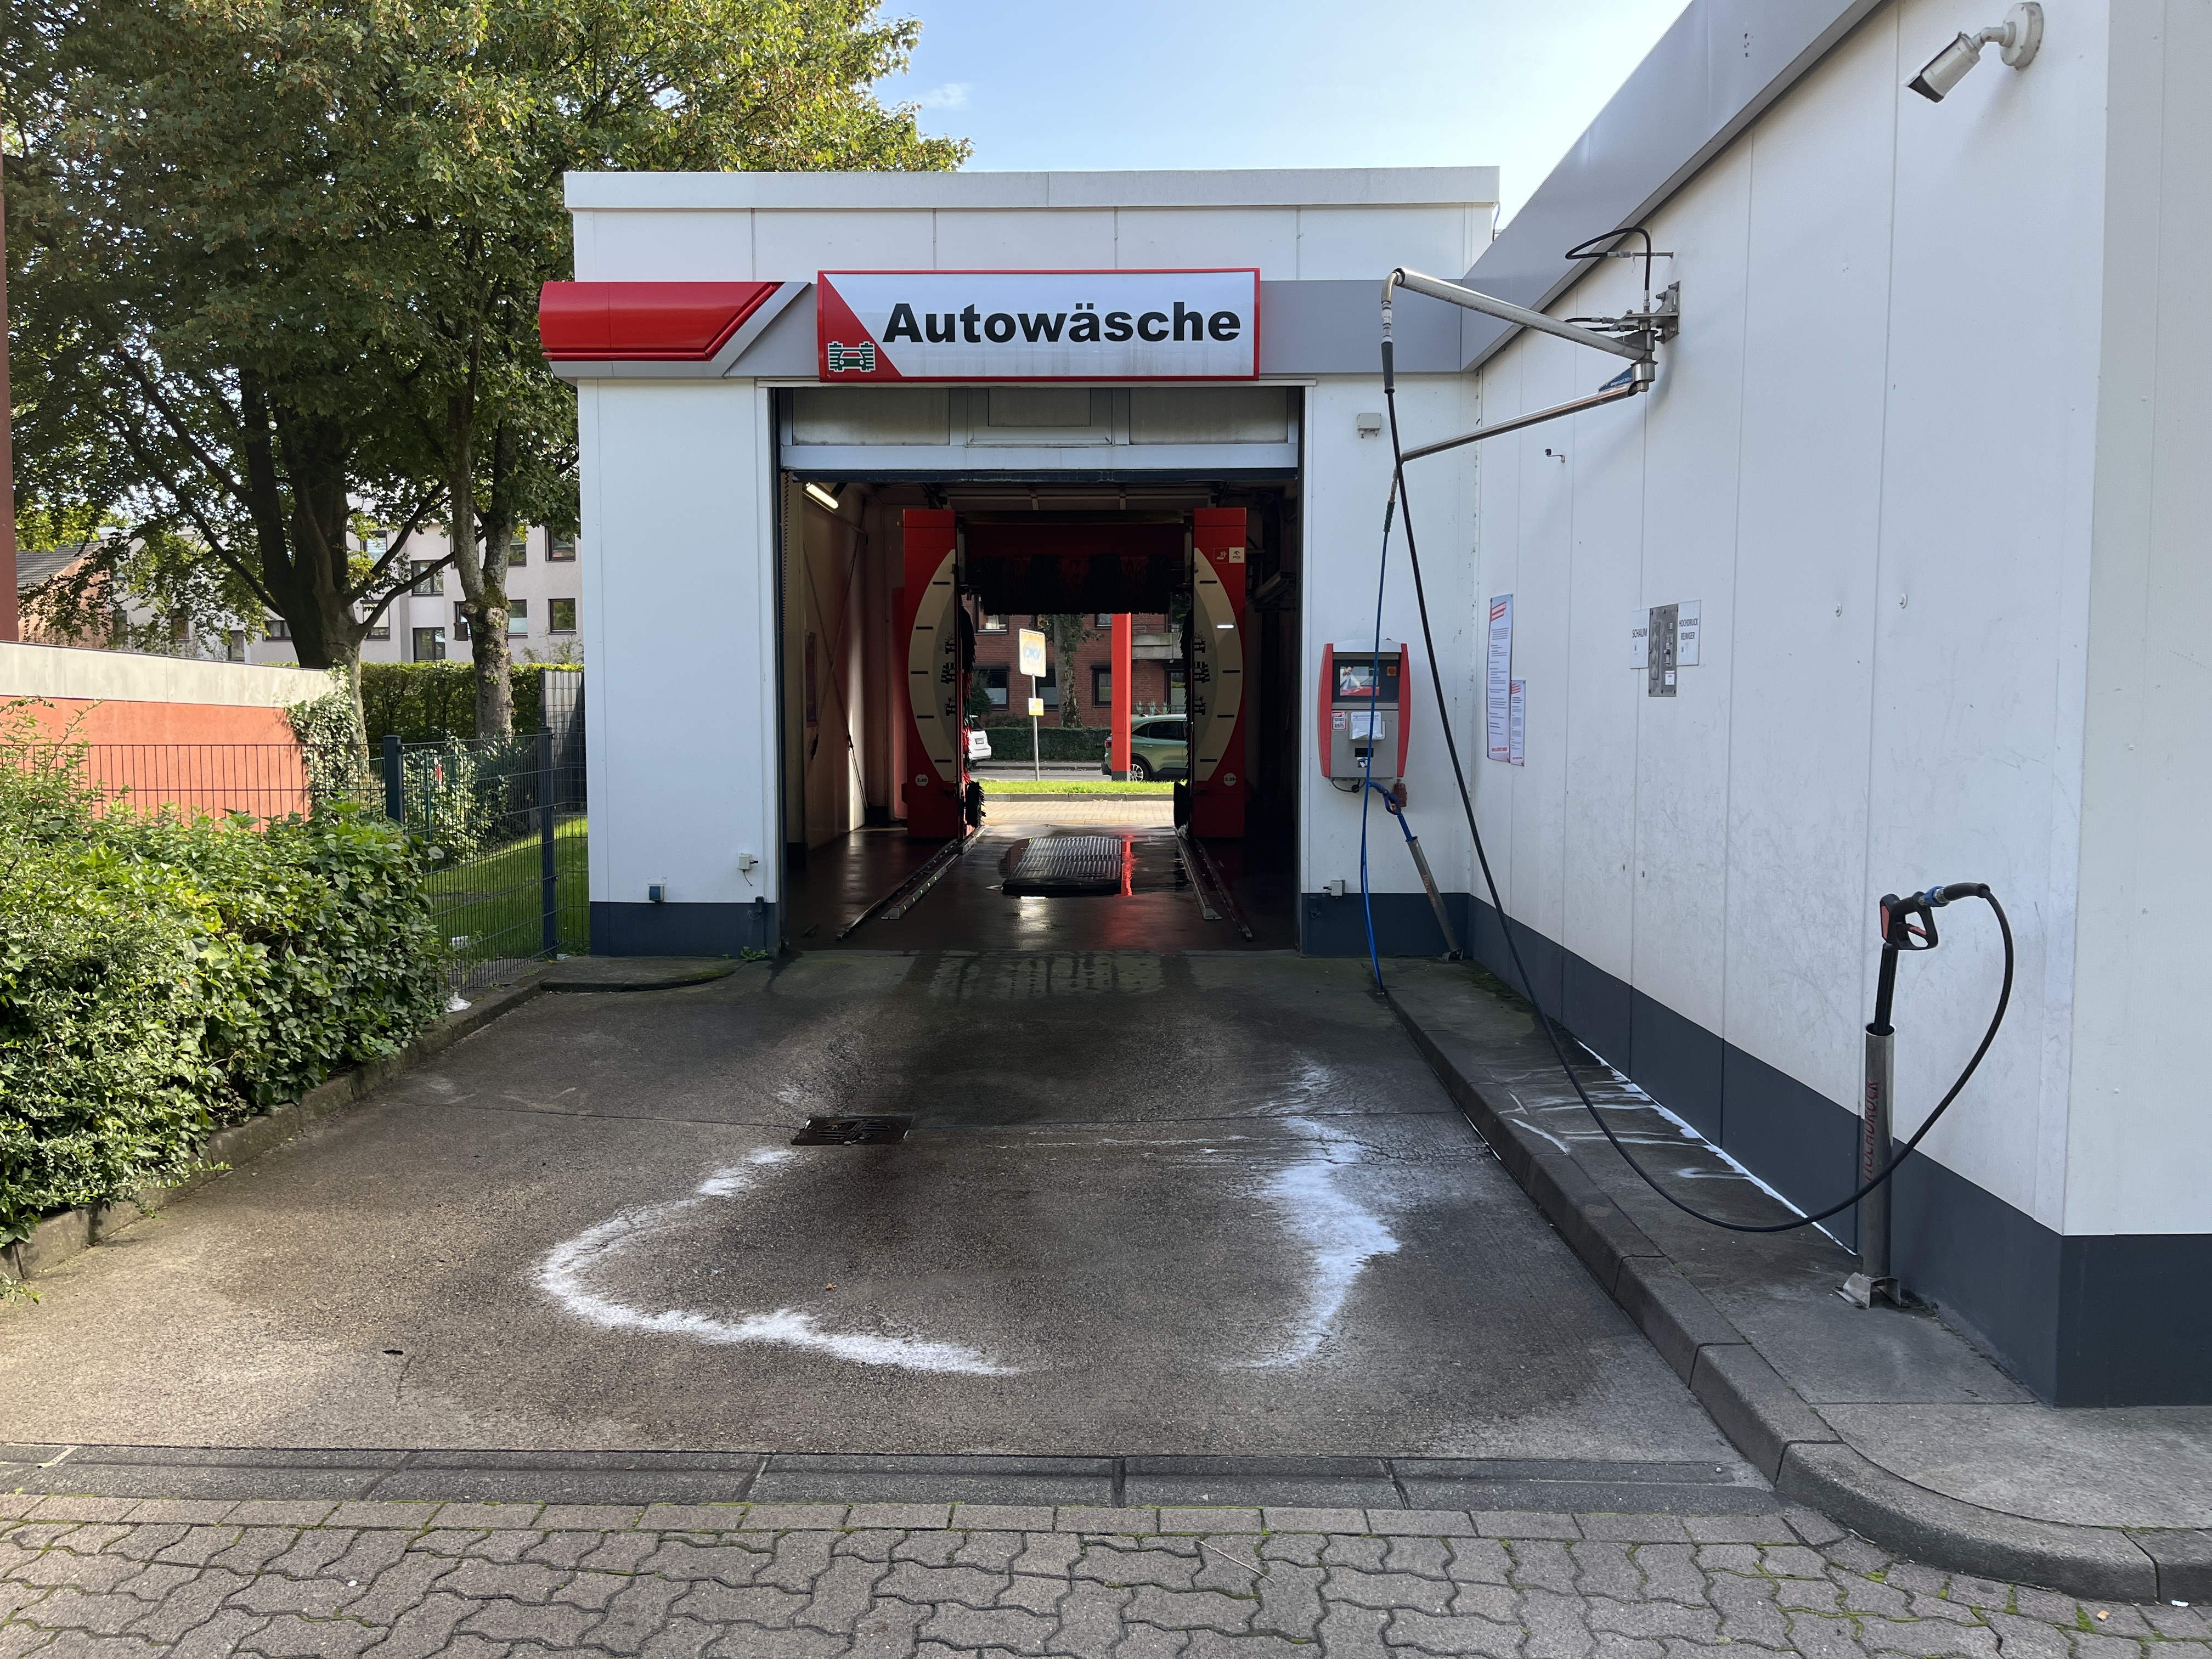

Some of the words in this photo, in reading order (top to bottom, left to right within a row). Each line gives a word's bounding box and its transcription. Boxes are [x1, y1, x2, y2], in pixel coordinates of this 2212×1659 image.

[883, 302, 1241, 343] Autowäsche
[1632, 628, 1647, 638] SCHAUM
[1025, 647, 1041, 660] DKV
